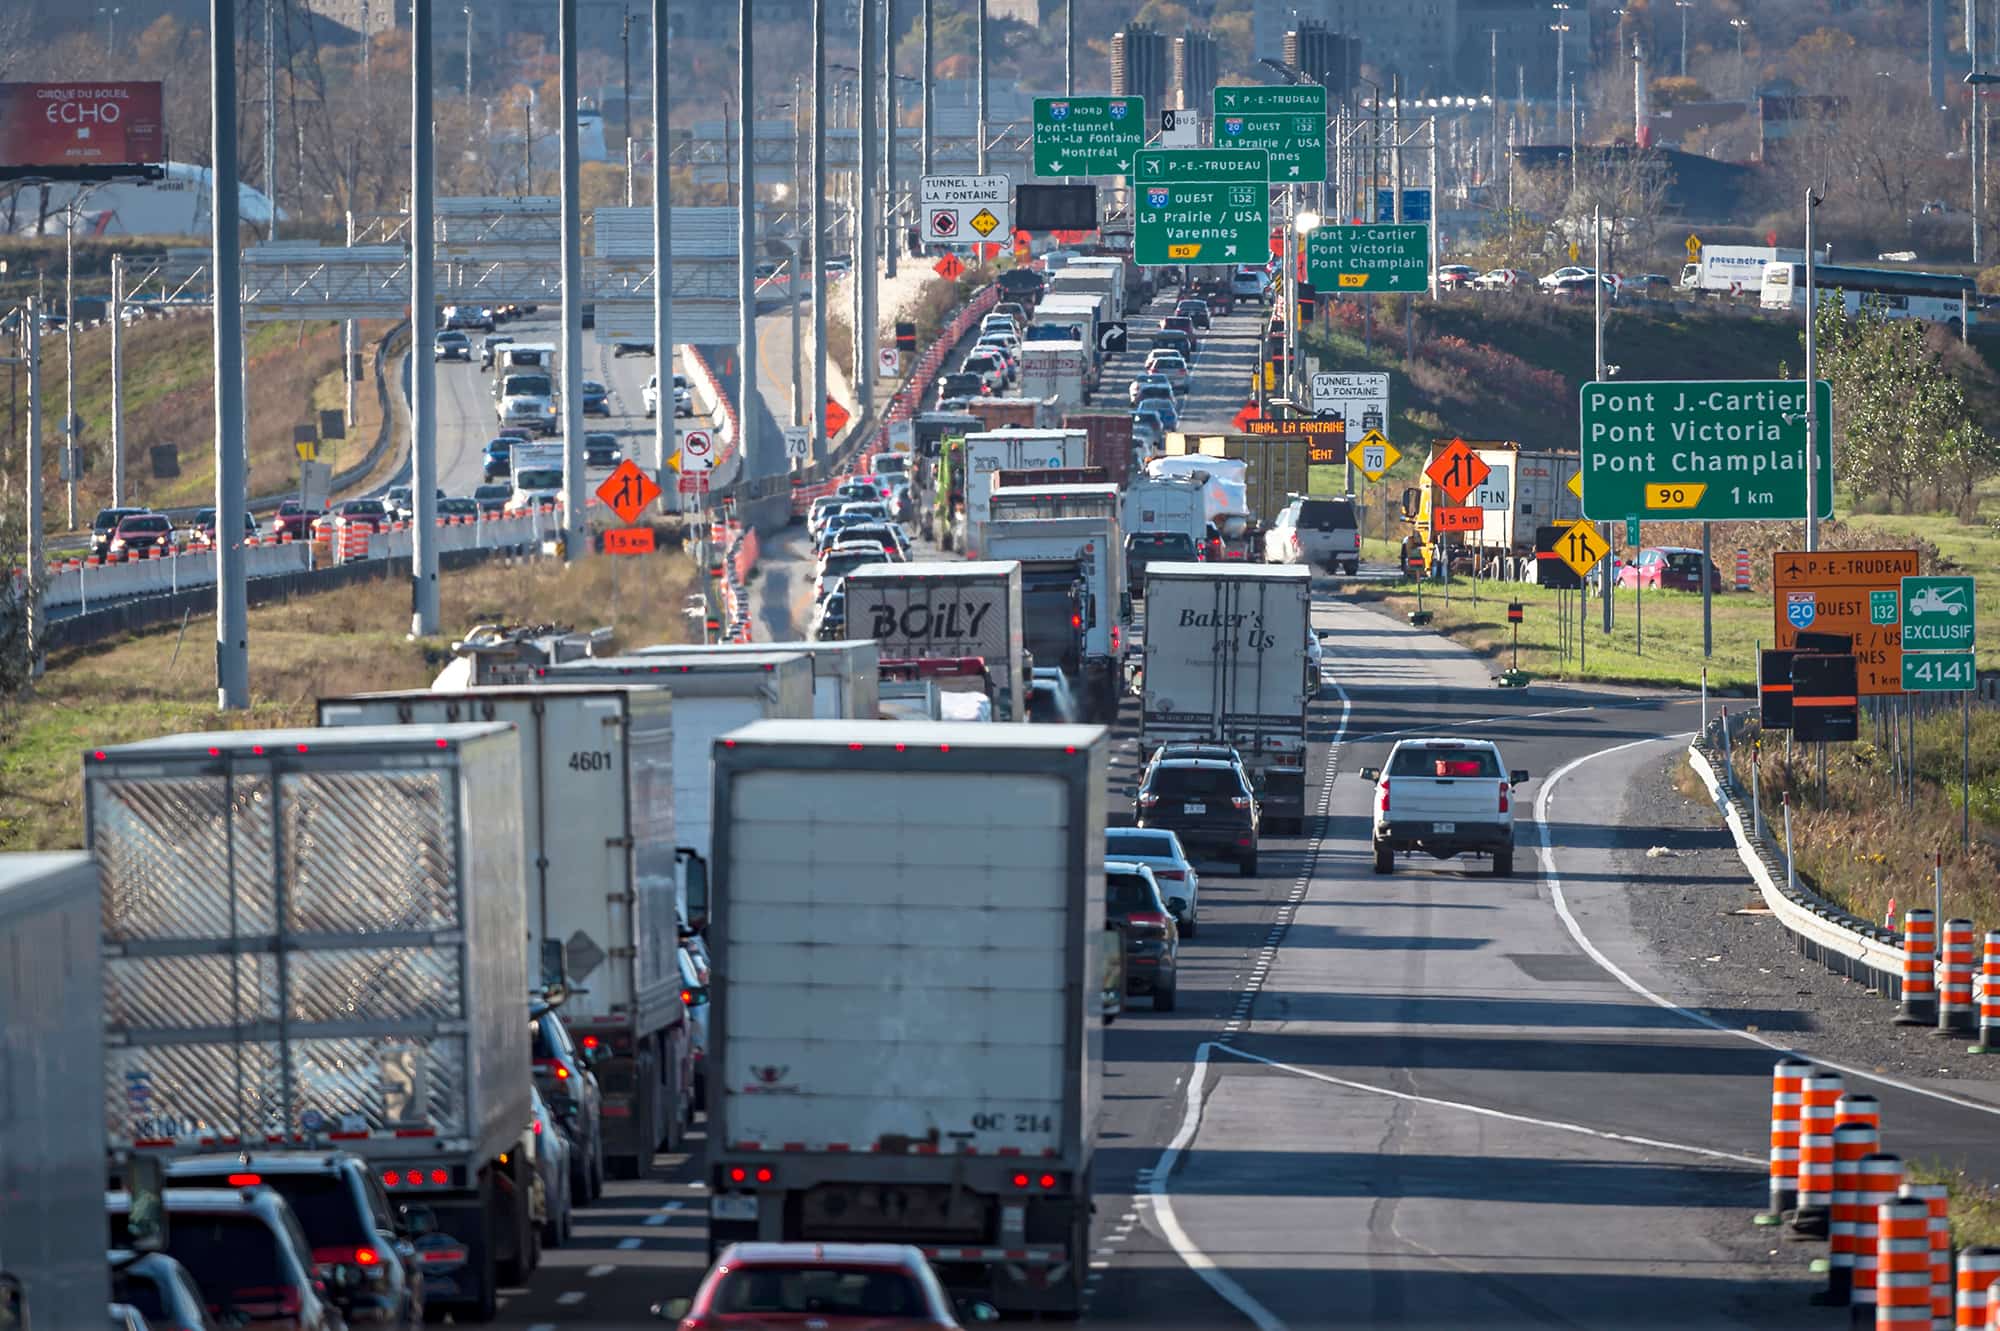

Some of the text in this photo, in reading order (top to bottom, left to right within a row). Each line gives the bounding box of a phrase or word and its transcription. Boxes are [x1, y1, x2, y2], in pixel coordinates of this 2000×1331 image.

[47, 103, 119, 123] ECHO
[1074, 107, 1103, 115] NORD
[1037, 121, 1114, 132] Pont-tunnel
[1176, 117, 1196, 125] BUS
[1248, 123, 1280, 131] OUEST
[1090, 133, 1140, 143] Fontaine
[1219, 139, 1232, 148] La
[1239, 139, 1278, 148] Prairie
[1298, 139, 1320, 147] USA
[1062, 147, 1117, 157] Montréal
[1270, 153, 1300, 161] nnes
[1169, 161, 1261, 170] P.-E.-TRUDEAU
[926, 180, 968, 188] TUNNEL
[926, 191, 998, 200] LA FONTAINE
[1151, 194, 1252, 204] 20 OUEST 132
[1140, 212, 1262, 224] La Prairie / USA
[1167, 227, 1238, 239] Varennes
[1311, 229, 1416, 240] Pont J.-Cartier
[1175, 247, 1190, 256] 90
[1312, 244, 1405, 254] Pont Victoria
[1312, 258, 1424, 270] Pont Champlain
[1345, 276, 1358, 284] 90
[1317, 377, 1351, 386] TUNNEL
[1316, 387, 1379, 397] LA FONTAINE
[1592, 390, 1806, 412] Pont J.-Cartier
[1283, 421, 1296, 433] LA
[1300, 421, 1344, 433] FONTAINE
[1592, 421, 1781, 442] Pont Victoria
[789, 439, 807, 452] 70
[1367, 455, 1382, 468] 70
[1592, 452, 1656, 472] Pont
[1481, 491, 1505, 503] FIN
[1659, 487, 1773, 504] 90 1 km
[1462, 514, 1479, 524] km
[631, 536, 649, 547] km
[1809, 560, 1912, 575] P.-E.-TRUDEAU
[1789, 601, 1895, 619] 20 OUEST 132
[1178, 608, 1265, 629] Baker's
[1248, 629, 1275, 648] Us
[1884, 632, 1902, 645] US
[1904, 625, 1972, 640] EXCLUSIF
[1869, 672, 1899, 685] 1 km
[568, 751, 612, 772] 4601
[972, 1112, 1051, 1133] QC 214
